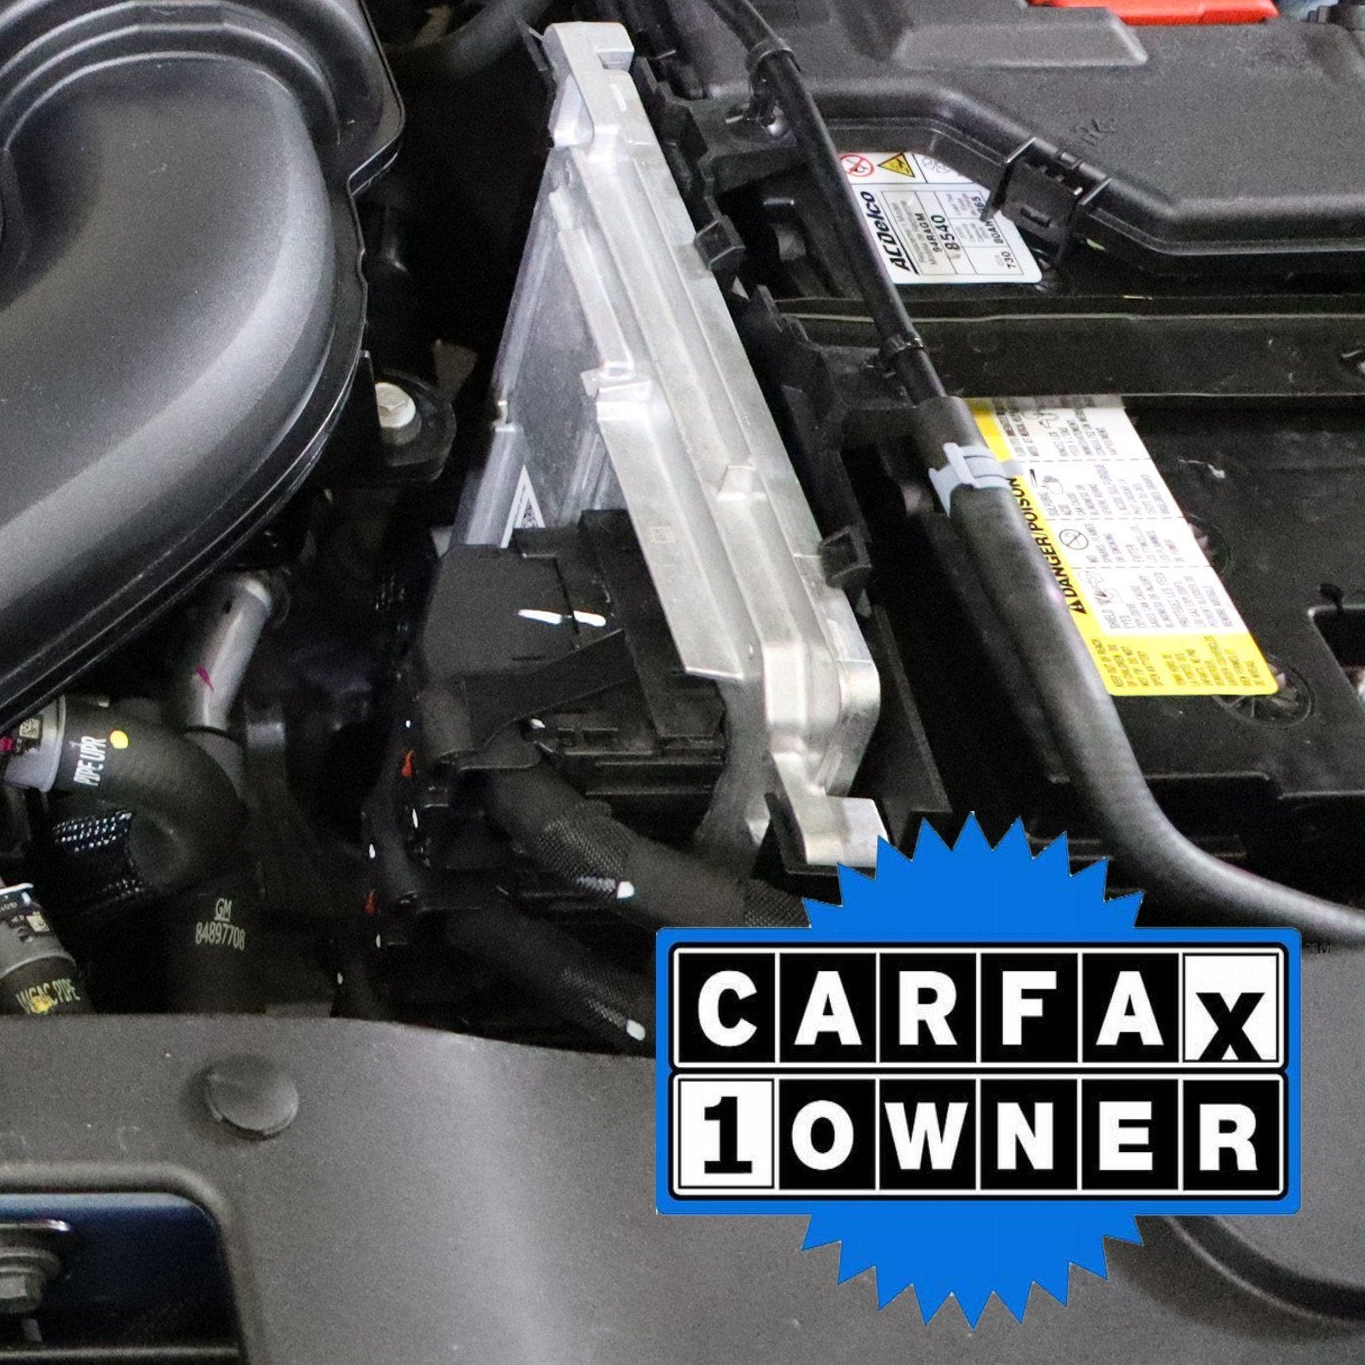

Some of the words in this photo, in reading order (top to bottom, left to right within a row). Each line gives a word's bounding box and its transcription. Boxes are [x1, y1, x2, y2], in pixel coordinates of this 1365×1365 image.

[860, 190, 911, 272] ACDelco
[914, 212, 942, 253] 94RAGM
[930, 214, 961, 251] 8540
[1001, 251, 1016, 270] 730
[1008, 477, 1078, 598] DANGER/POISON
[81, 735, 108, 763] UPR
[73, 758, 102, 787] PIPE
[214, 897, 233, 922] GM
[195, 921, 246, 951] 84897708
[52, 978, 81, 1005] PIPE
